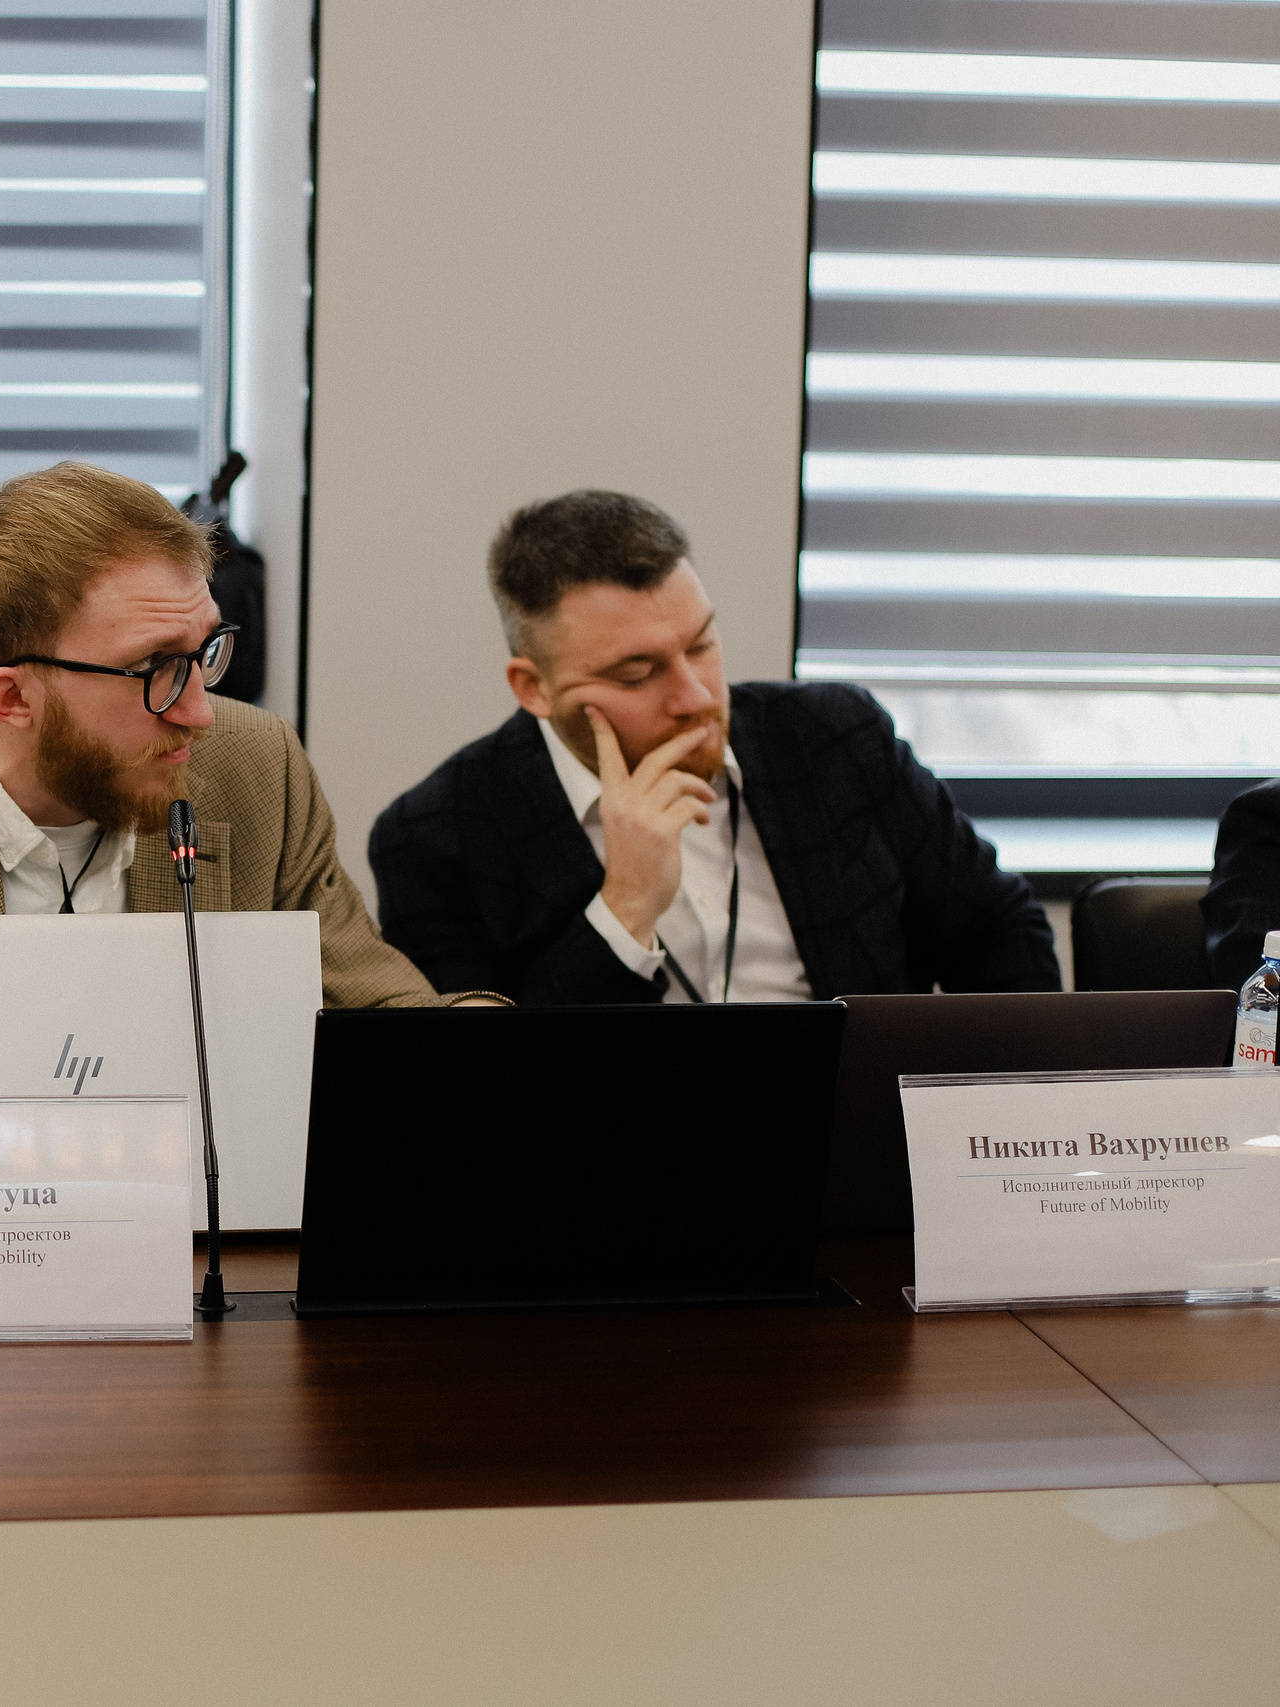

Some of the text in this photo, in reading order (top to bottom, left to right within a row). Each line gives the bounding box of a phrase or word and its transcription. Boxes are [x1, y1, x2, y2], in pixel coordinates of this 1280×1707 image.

[1238, 1043, 1276, 1064] sam
[968, 1132, 1231, 1162] Никита Вахрушев
[1002, 1176, 1205, 1194] Исполнительный директор
[1040, 1196, 1171, 1214] Future of Mobility
